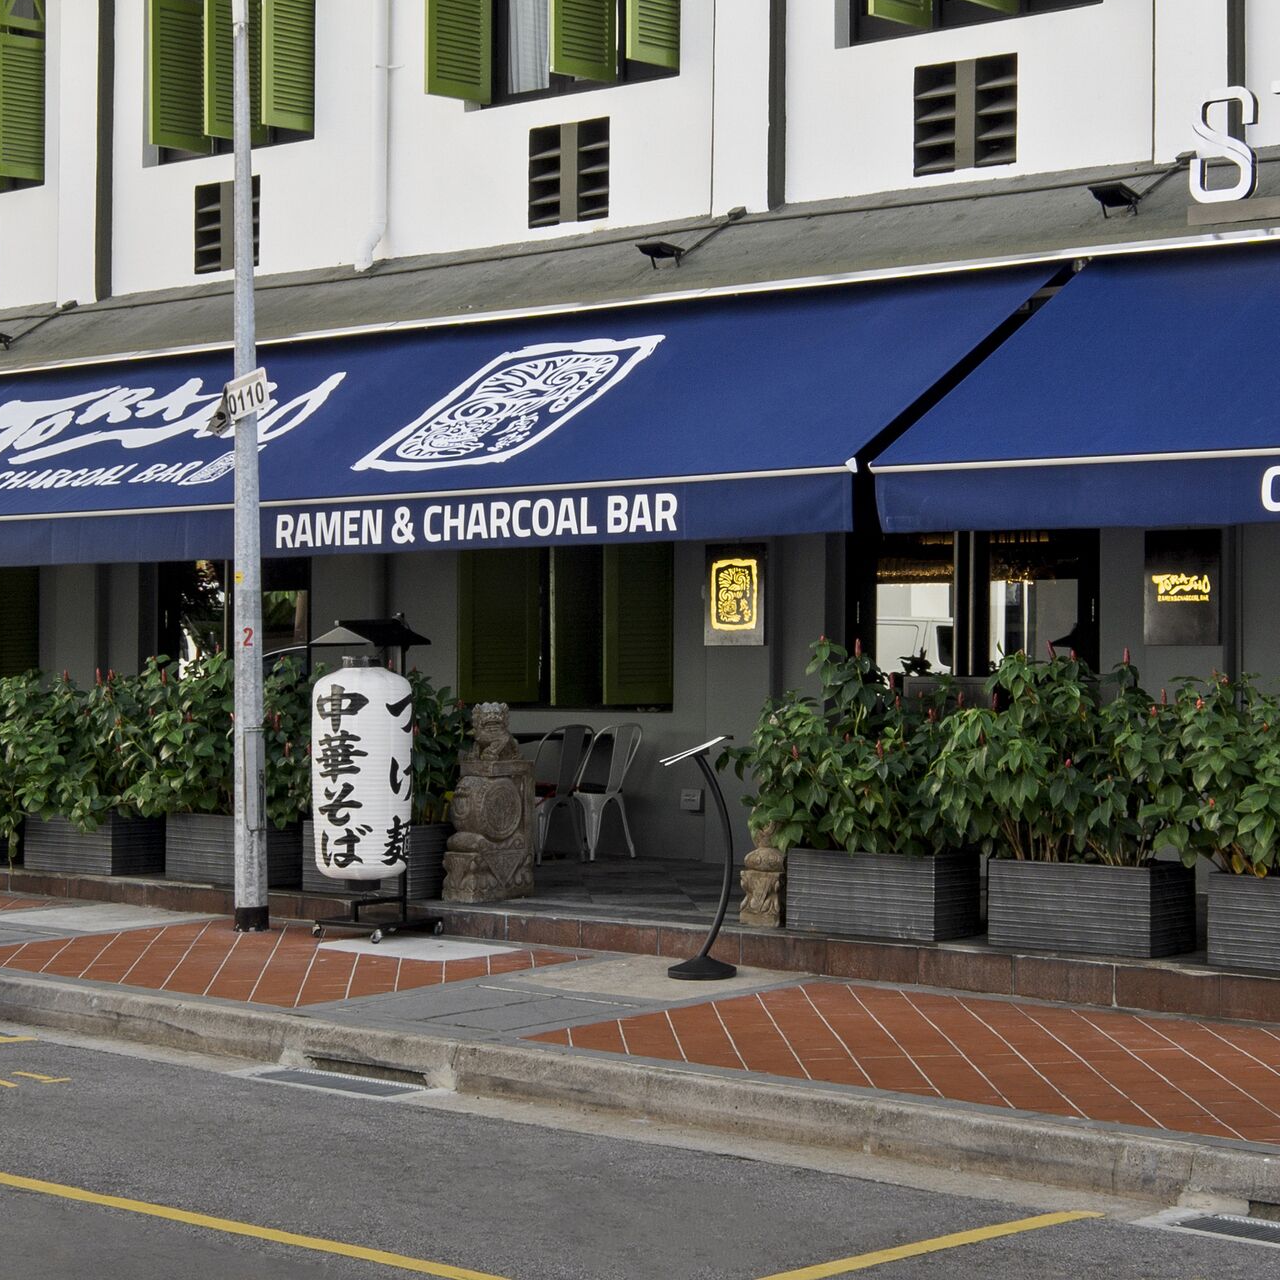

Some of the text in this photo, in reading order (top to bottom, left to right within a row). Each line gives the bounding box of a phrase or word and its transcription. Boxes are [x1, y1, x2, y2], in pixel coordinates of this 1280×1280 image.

[228, 381, 265, 415] 0110
[128, 461, 204, 484] BAR
[276, 493, 678, 549] RAMEN & CHARCOAL BAR
[243, 627, 254, 647] 2
[316, 683, 374, 869] 中華そば
